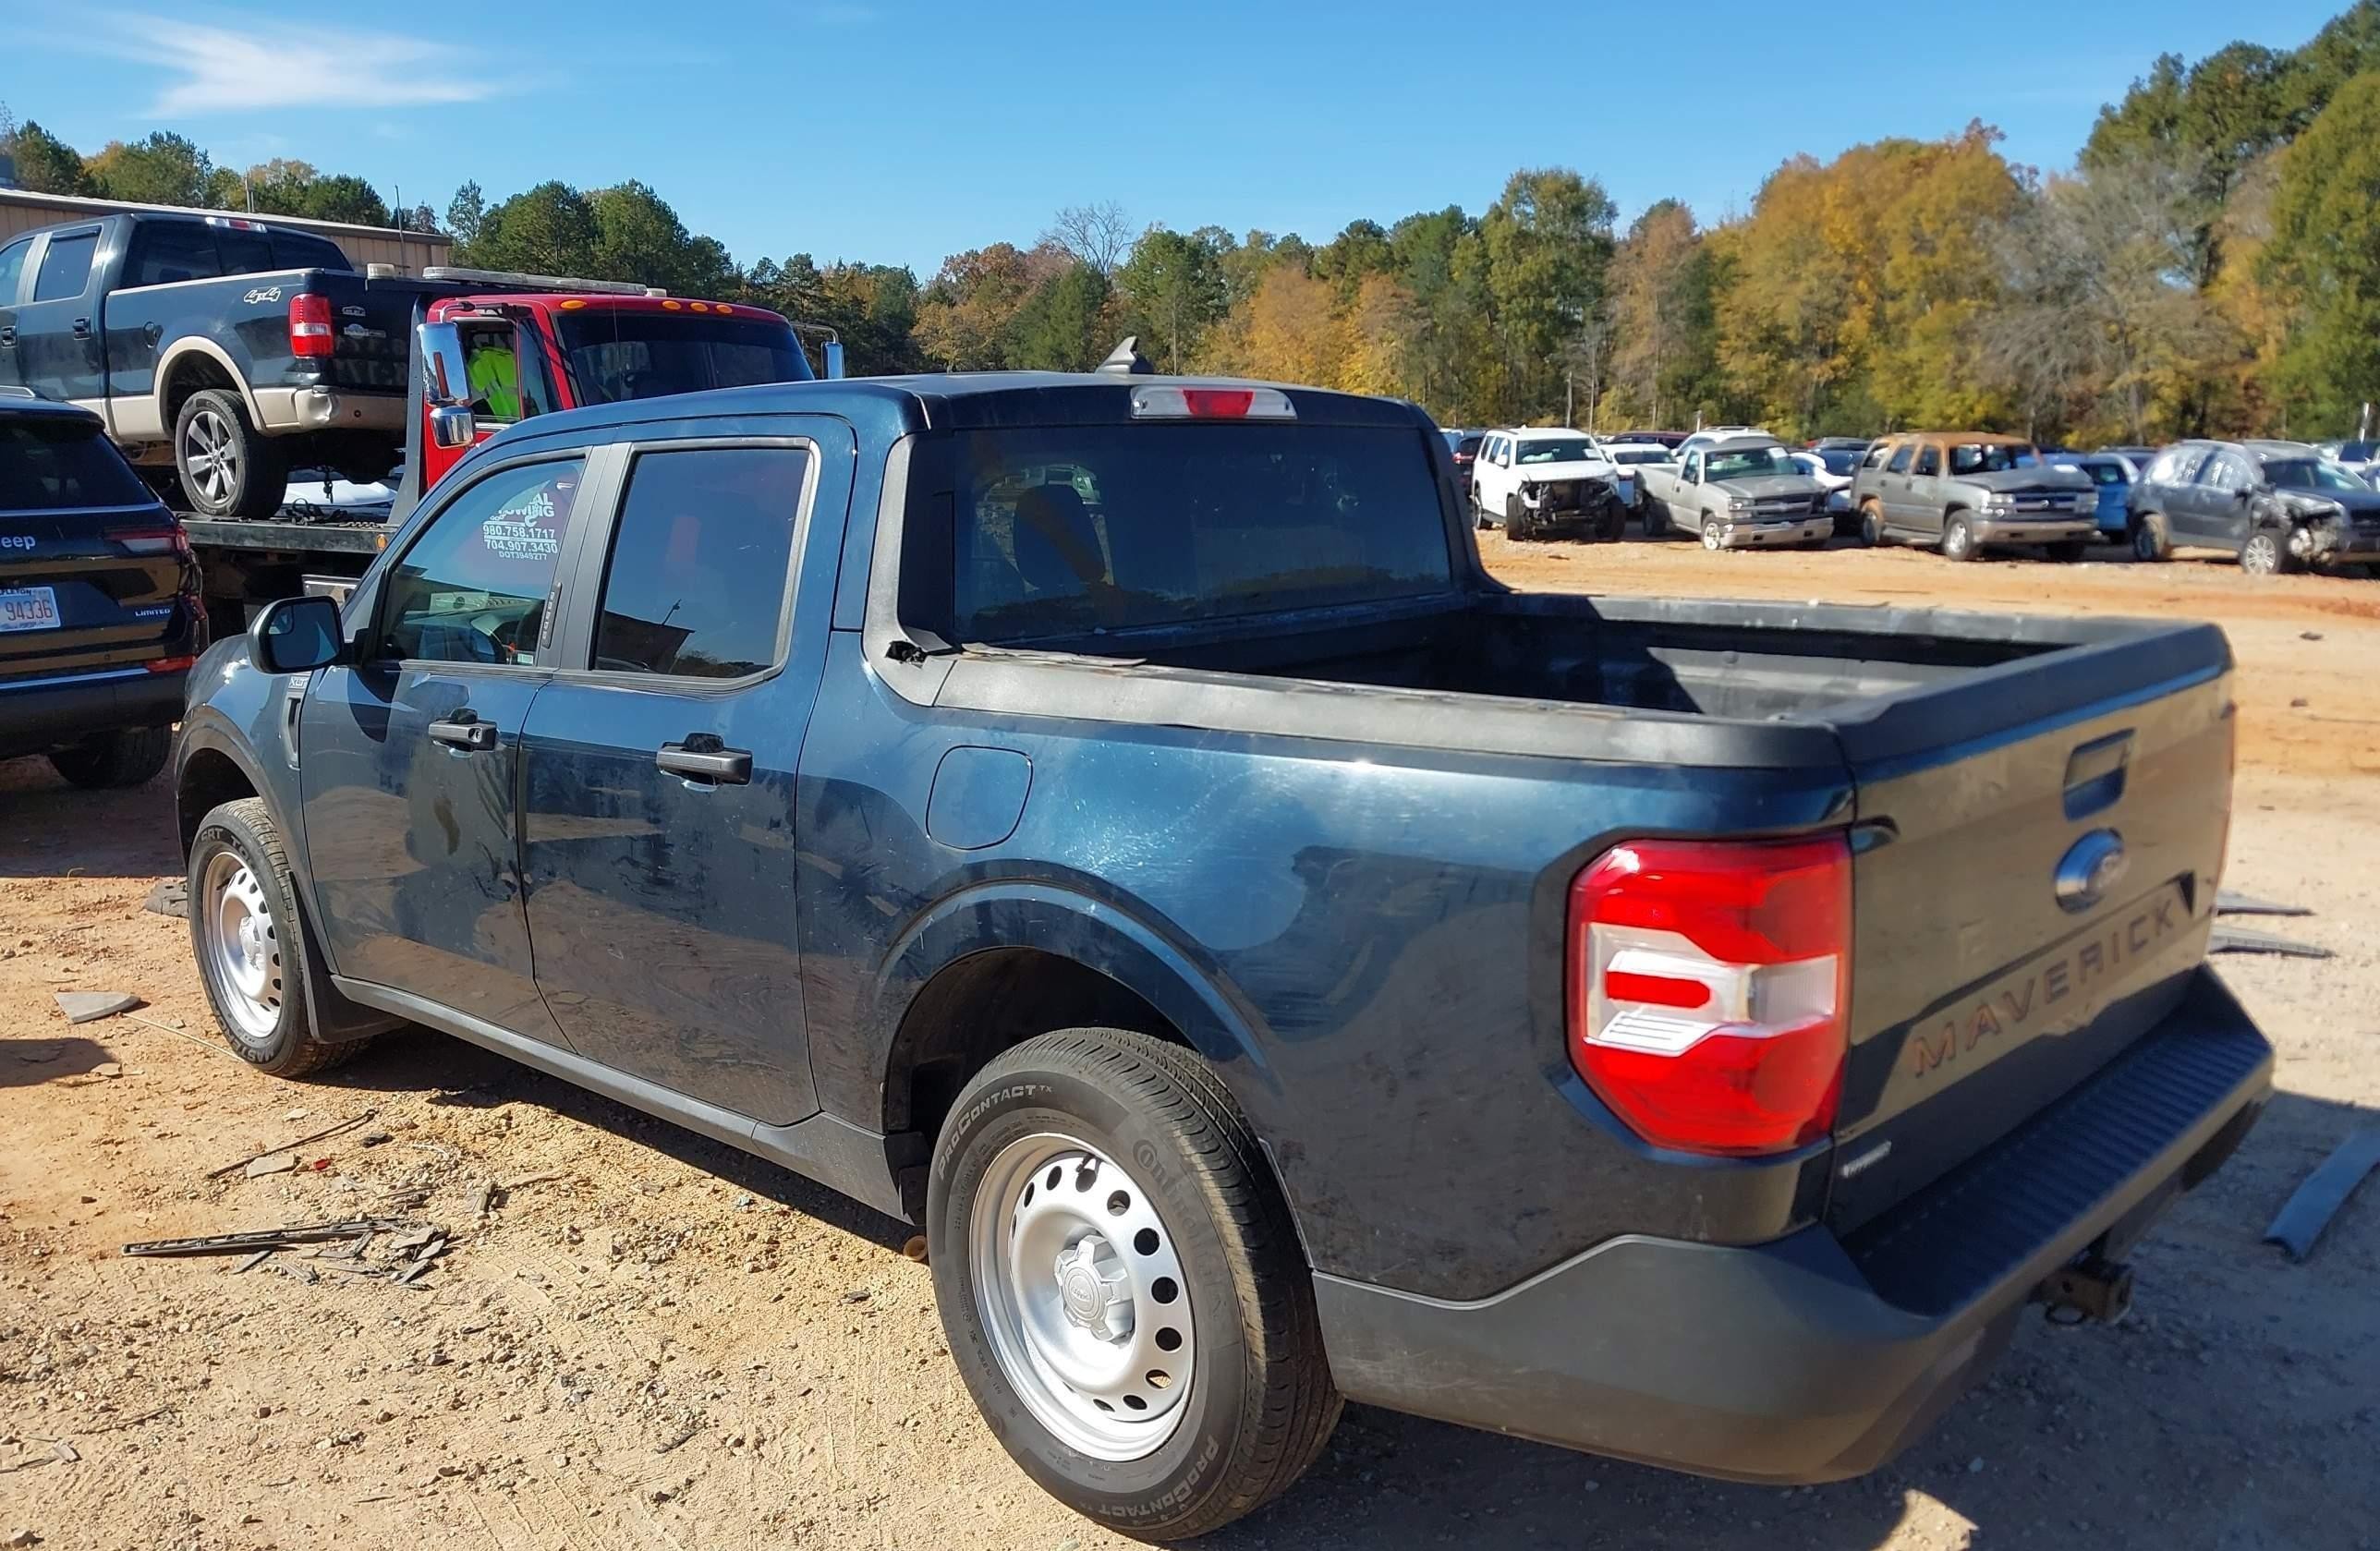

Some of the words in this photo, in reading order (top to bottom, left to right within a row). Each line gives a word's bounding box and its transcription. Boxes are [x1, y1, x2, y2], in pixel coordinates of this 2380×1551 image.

[482, 525, 555, 539] 980.758.1717
[0, 535, 36, 551] eep
[484, 539, 558, 554] 704.907.3430
[6, 599, 54, 621] 94336
[1912, 899, 2175, 1079] MAVERICK
